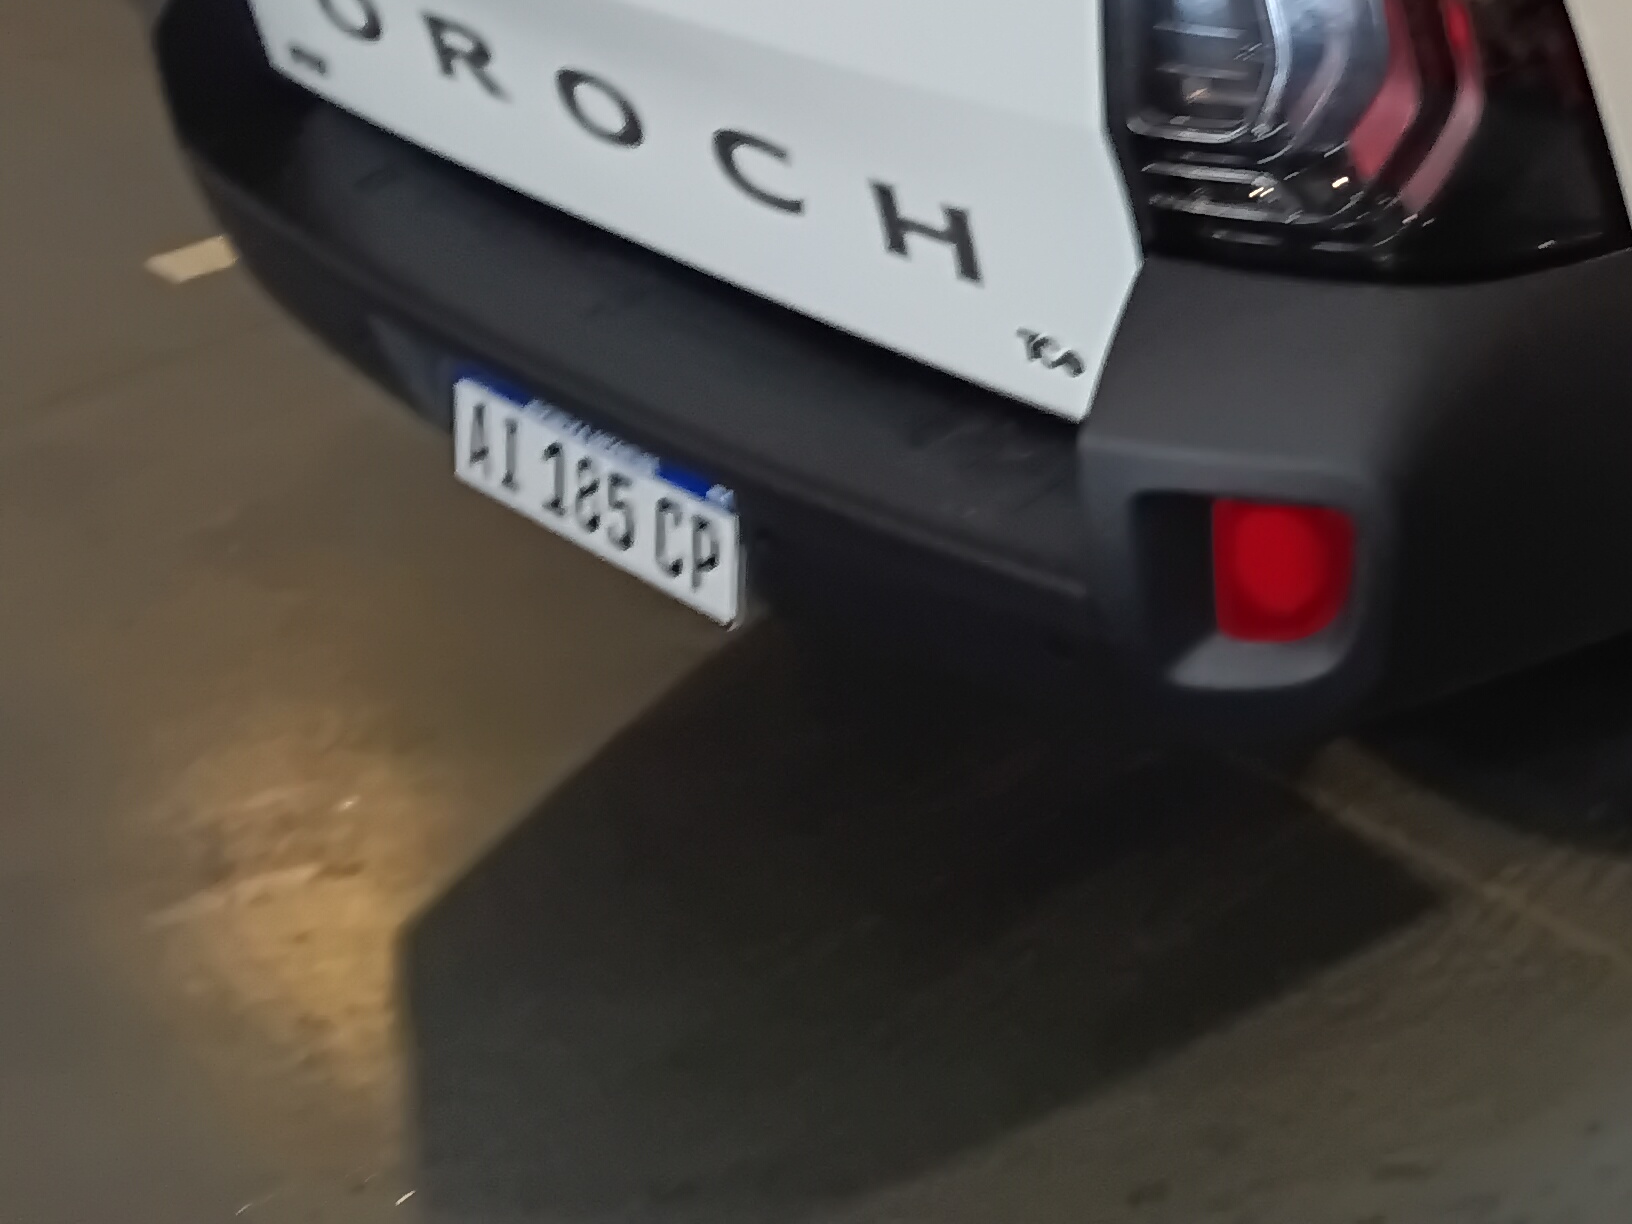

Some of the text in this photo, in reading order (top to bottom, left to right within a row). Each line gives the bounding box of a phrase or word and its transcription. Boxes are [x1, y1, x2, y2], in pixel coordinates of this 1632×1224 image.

[469, 403, 521, 492] AI
[541, 442, 635, 552] 185
[655, 497, 721, 592] CP
